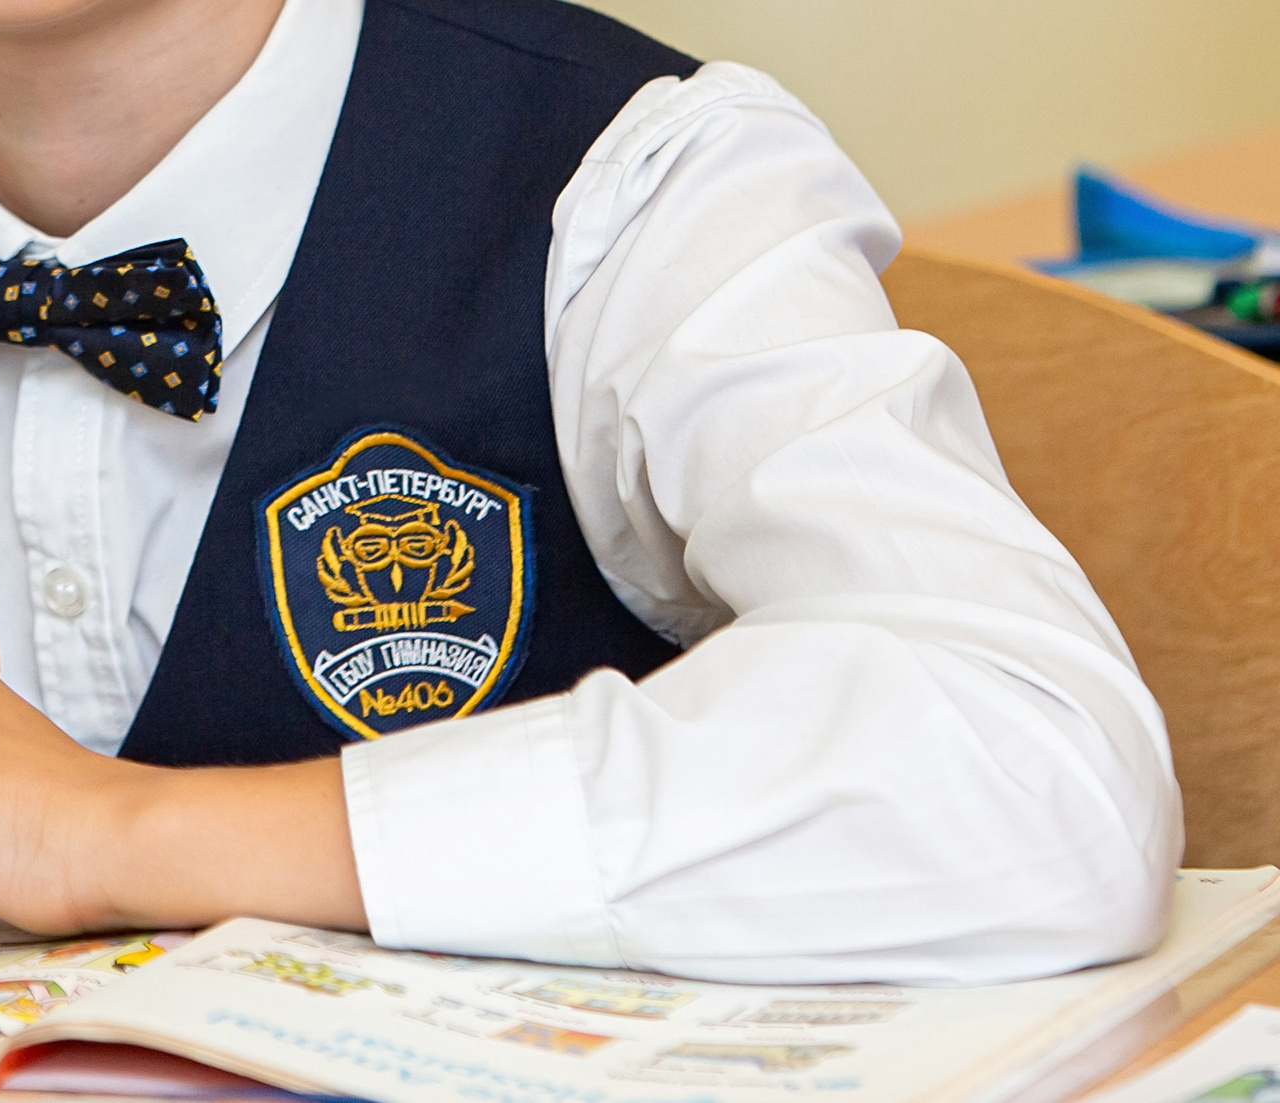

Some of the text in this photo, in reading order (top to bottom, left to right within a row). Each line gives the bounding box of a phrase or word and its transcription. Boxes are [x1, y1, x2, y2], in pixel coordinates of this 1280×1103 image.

[286, 469, 502, 532] САНКТ-ПЕТЕРБУРГ
[329, 638, 489, 694] ГБОУ ГИМНАЗИЯ
[359, 680, 454, 717] №406
